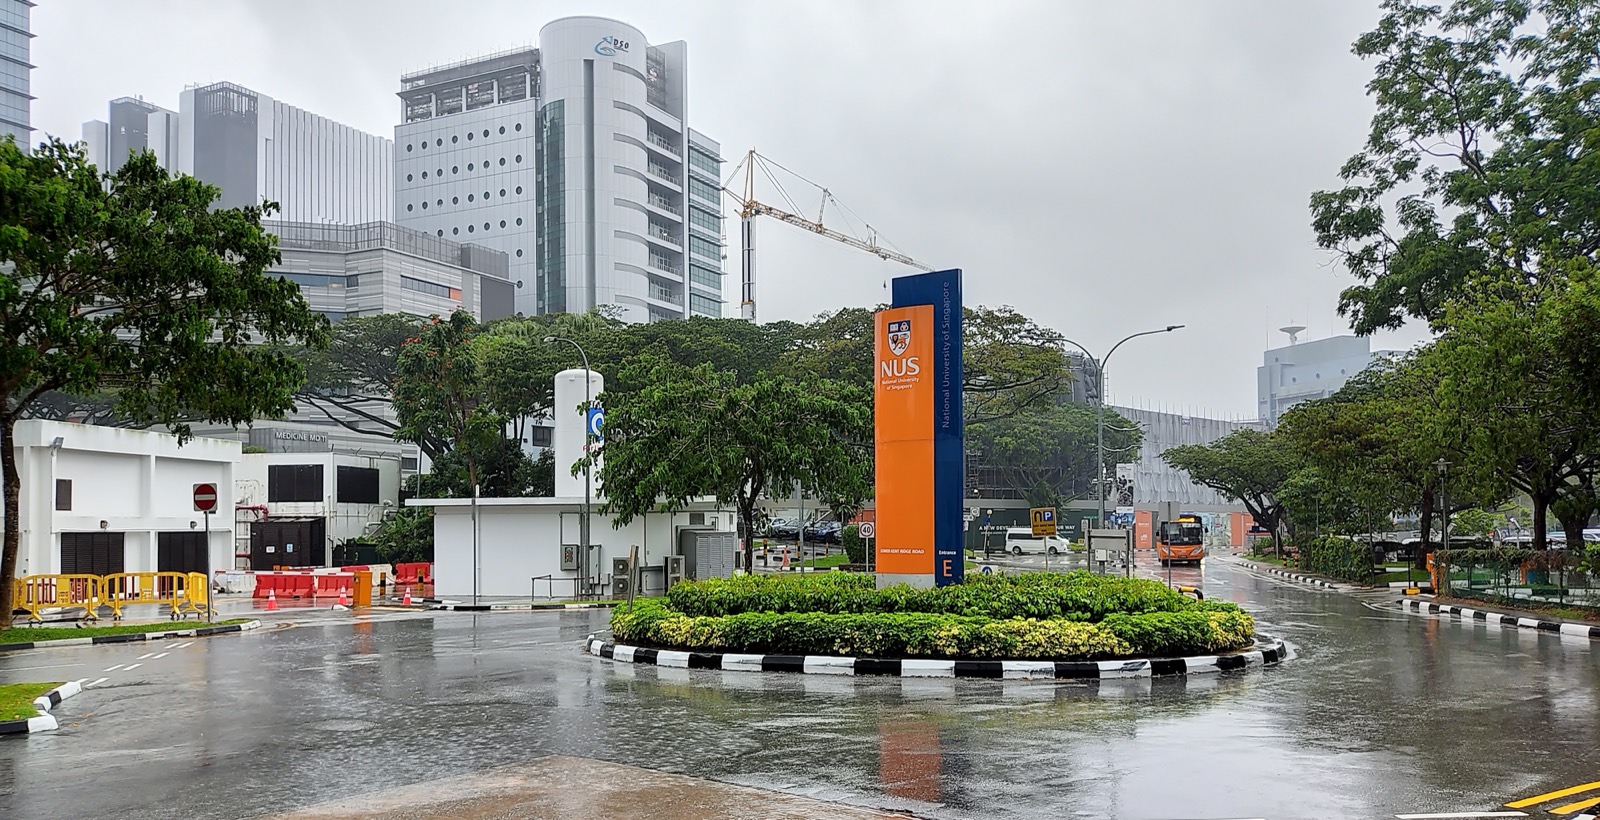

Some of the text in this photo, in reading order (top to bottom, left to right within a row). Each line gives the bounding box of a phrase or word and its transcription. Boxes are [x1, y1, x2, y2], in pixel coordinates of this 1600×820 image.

[613, 38, 629, 49] DSO
[942, 281, 951, 428] National University of Singapore
[881, 357, 920, 378] NUS
[276, 432, 307, 441] MEDICINE
[310, 434, 320, 442] MD
[1044, 511, 1051, 520] P
[943, 560, 953, 577] E
